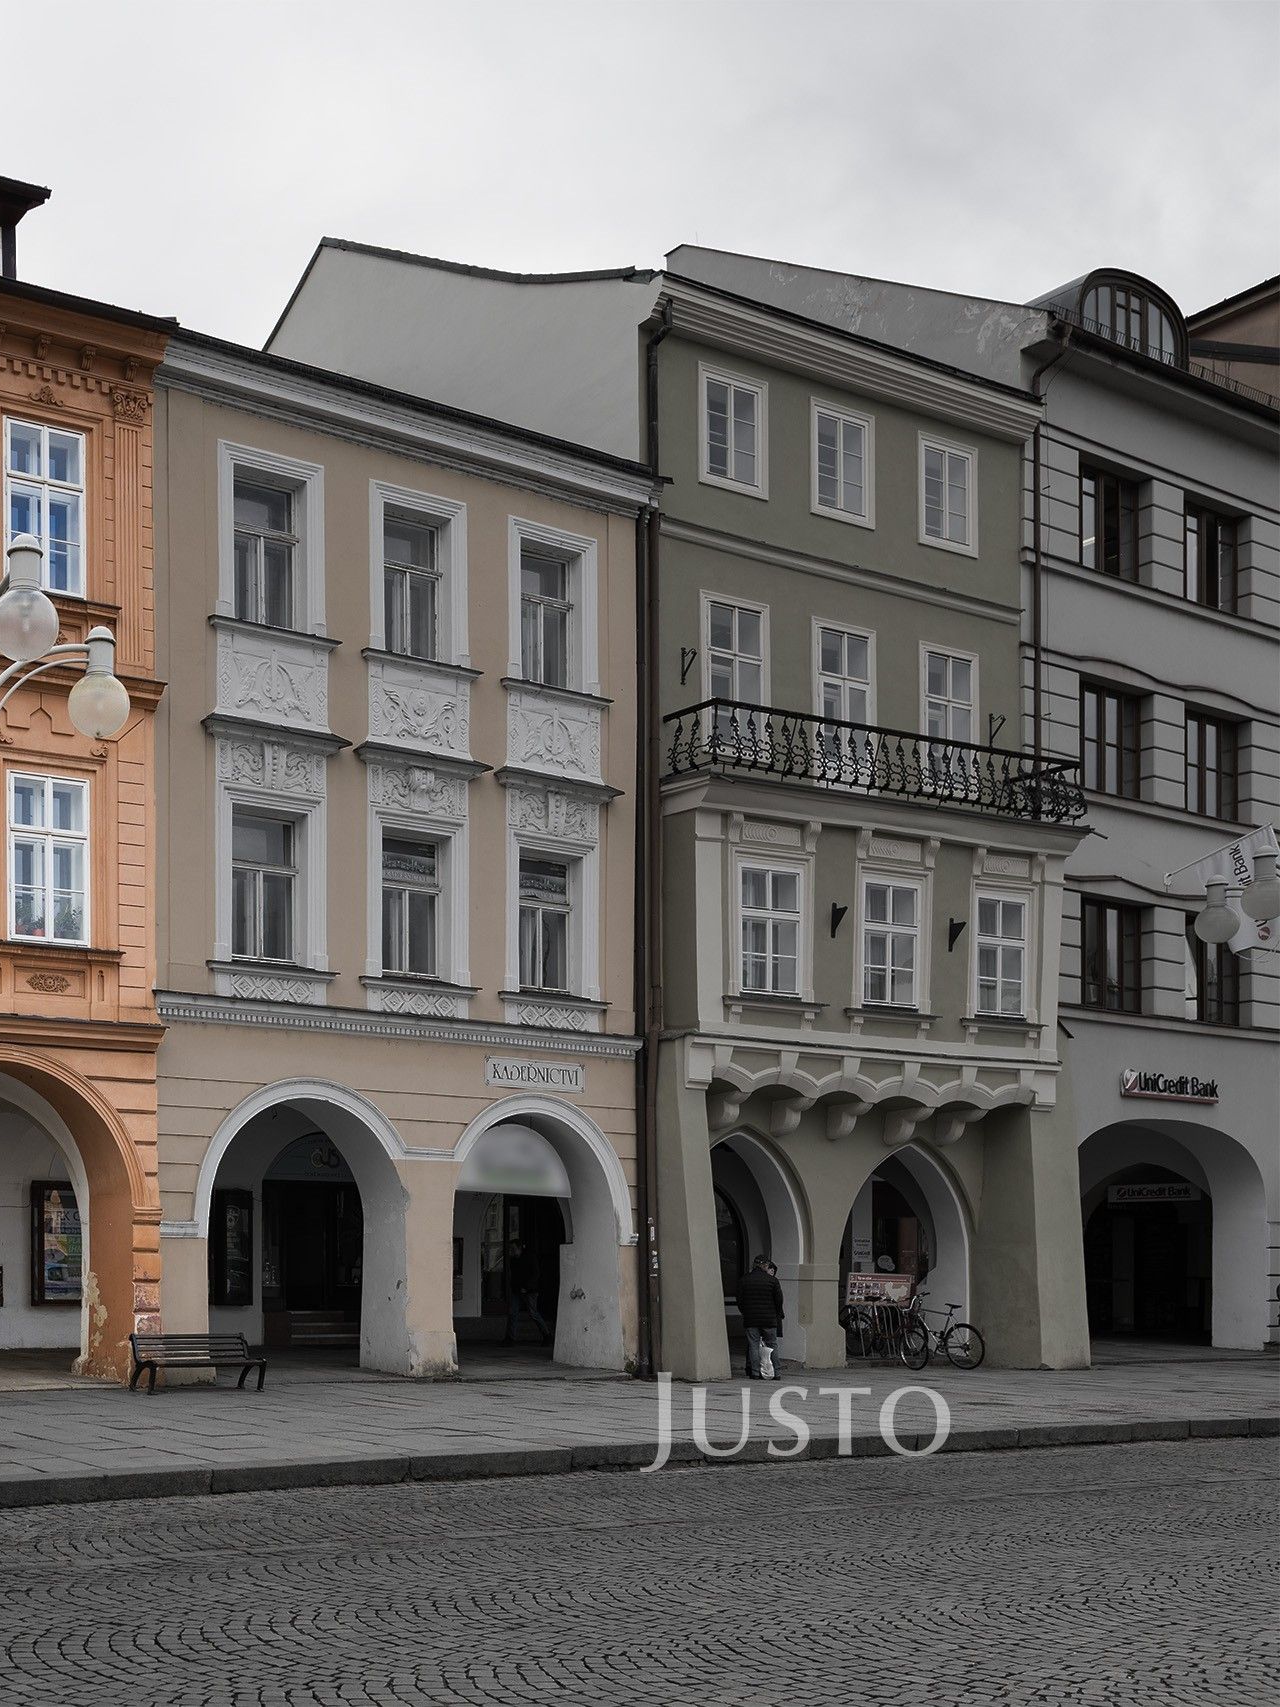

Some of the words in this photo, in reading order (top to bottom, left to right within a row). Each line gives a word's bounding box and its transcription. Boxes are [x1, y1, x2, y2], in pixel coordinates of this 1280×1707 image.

[1229, 844, 1249, 876] Bank
[493, 1063, 578, 1085] KADEŘNICTVÍ
[1138, 1072, 1189, 1095] UniCredit
[1192, 1077, 1219, 1098] Bank
[1127, 1187, 1167, 1197] UniCredit
[1168, 1186, 1192, 1196] Bank
